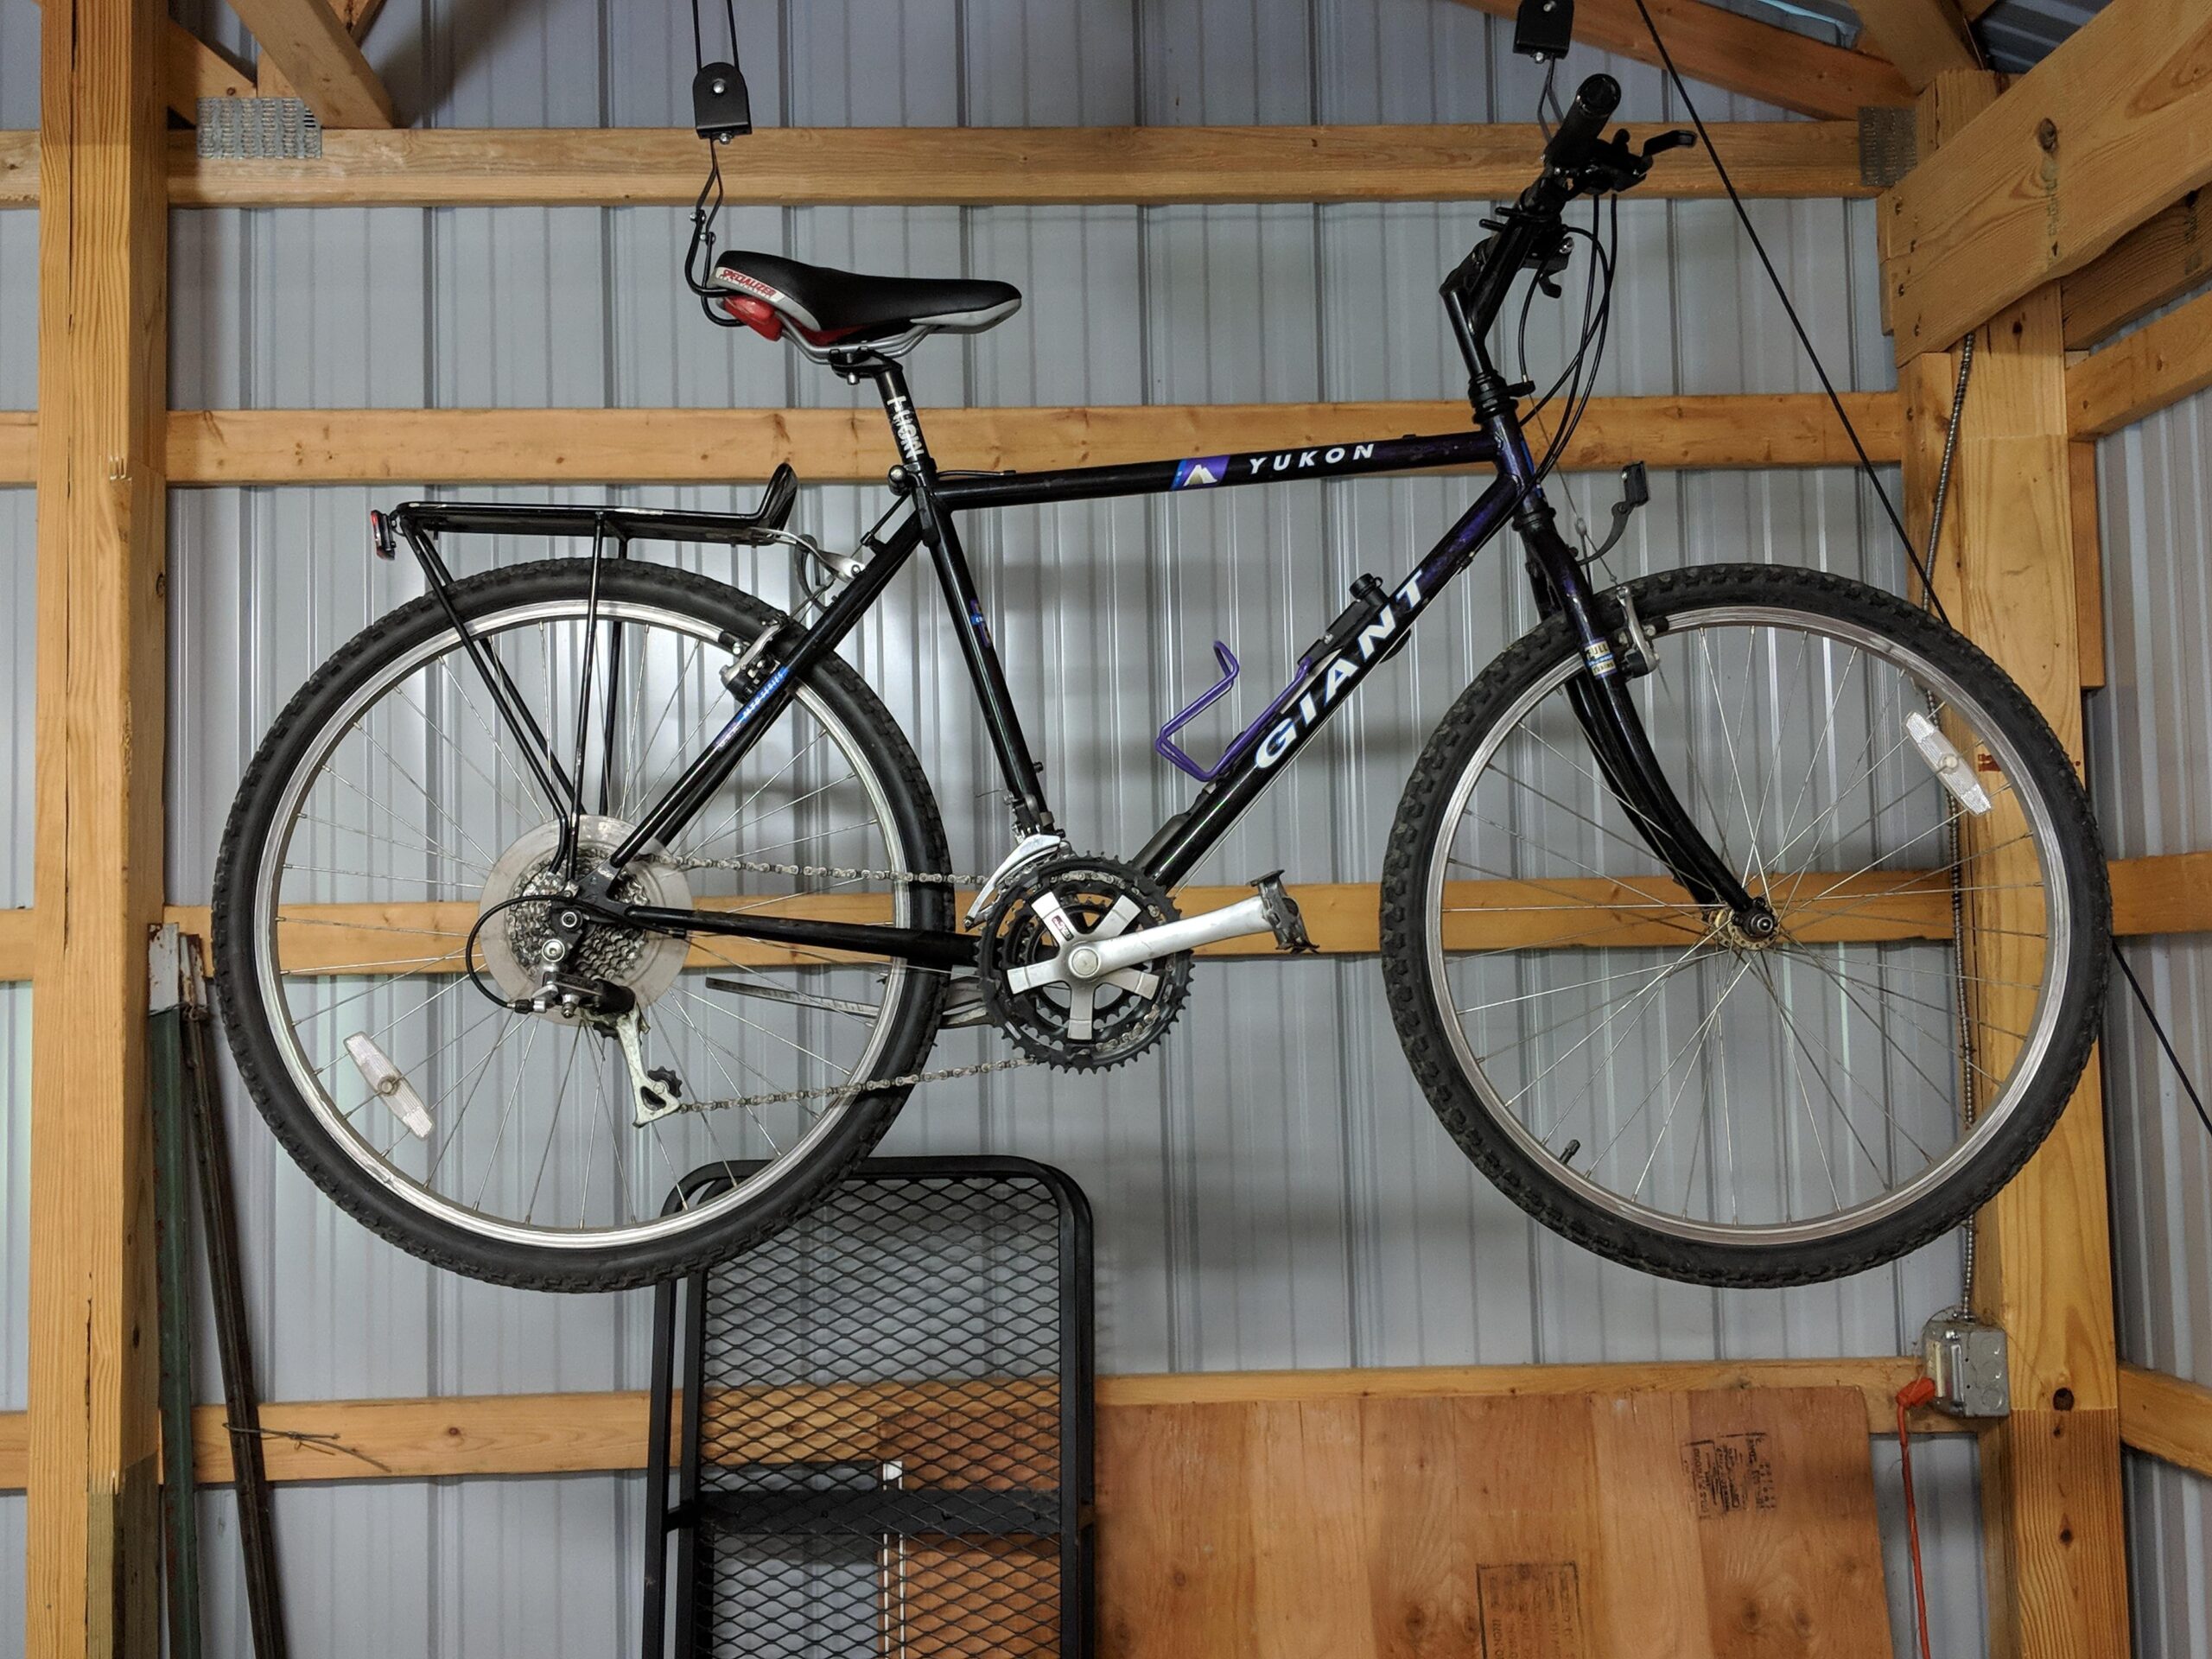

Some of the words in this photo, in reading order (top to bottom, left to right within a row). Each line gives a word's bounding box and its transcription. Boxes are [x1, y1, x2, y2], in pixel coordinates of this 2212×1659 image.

[721, 269, 777, 297] SPECIALIZED
[1249, 443, 1375, 474] YUKON
[1255, 569, 1423, 769] GIANT
